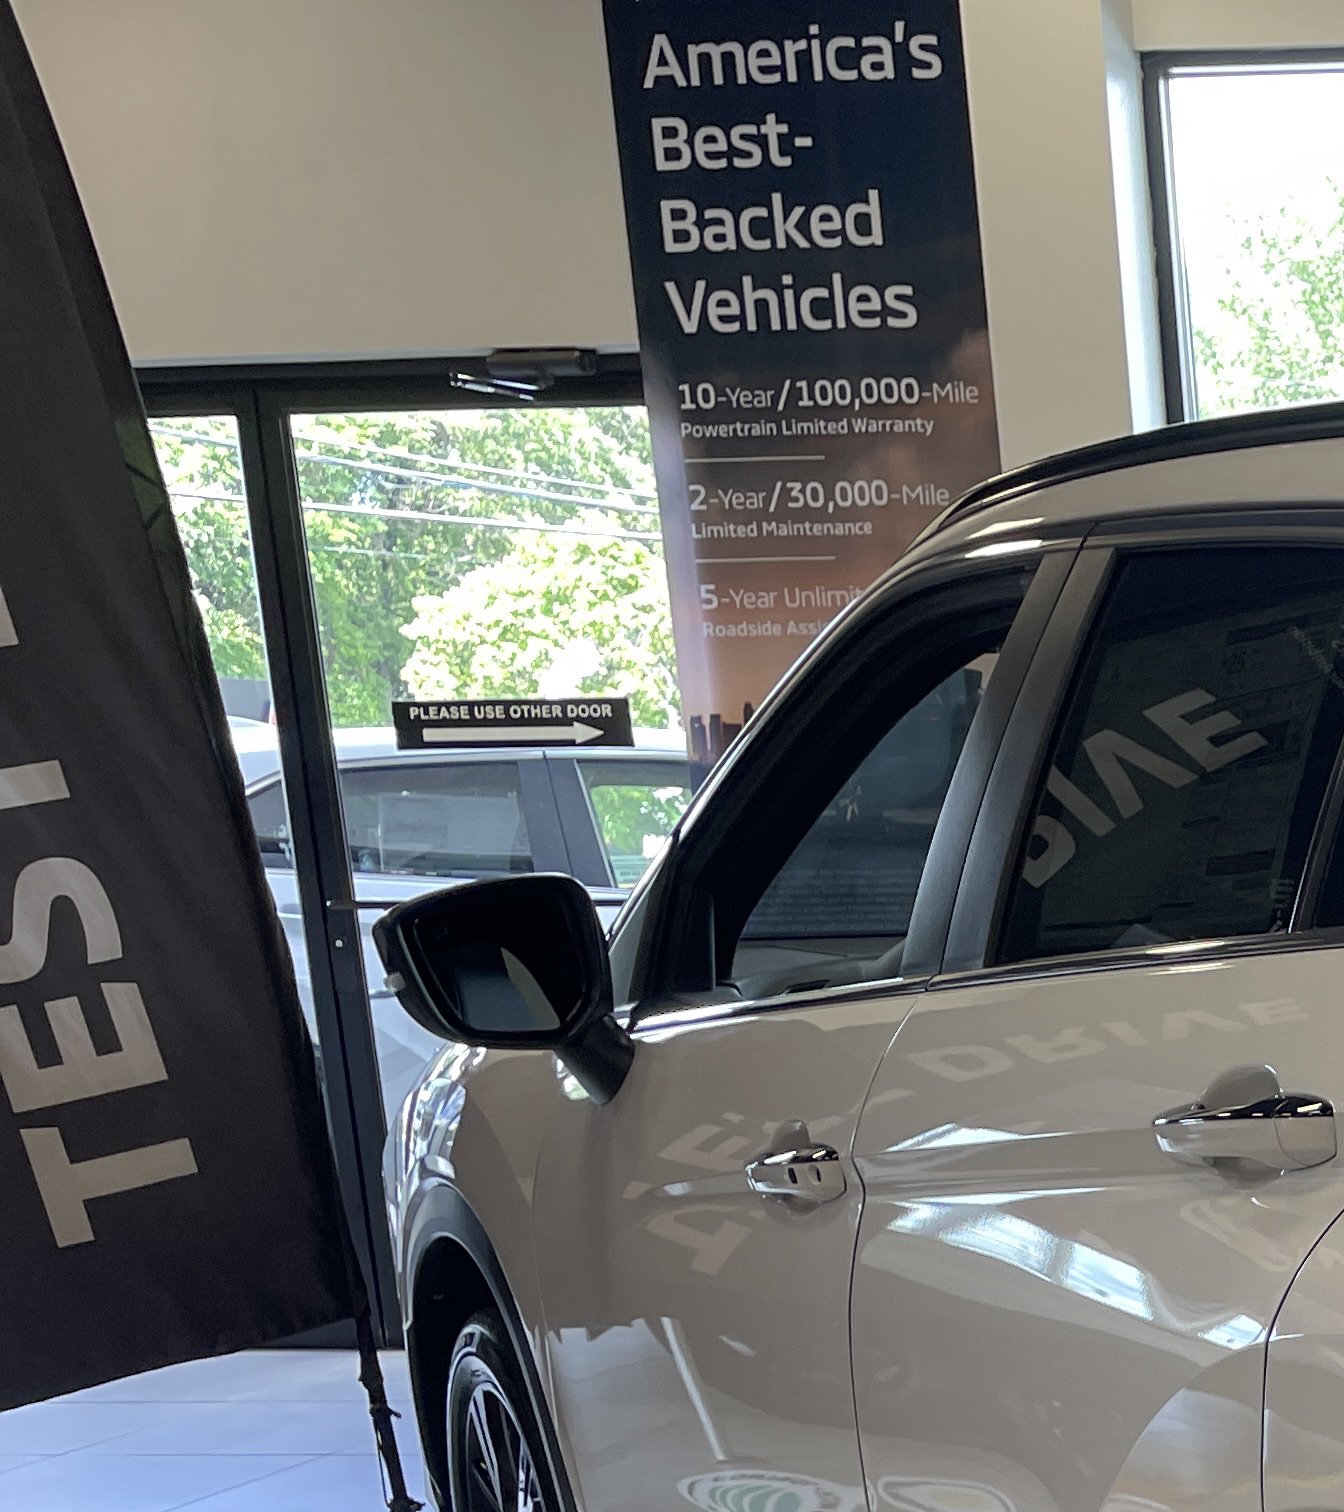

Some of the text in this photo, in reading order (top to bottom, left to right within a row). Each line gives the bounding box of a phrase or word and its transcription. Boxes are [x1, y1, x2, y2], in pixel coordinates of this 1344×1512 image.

[642, 20, 943, 89] America's
[650, 112, 814, 172] Best-
[659, 188, 885, 254] Backed
[664, 272, 918, 335] Vehicles
[680, 415, 935, 439] Powertrain Limited Warranty
[691, 518, 873, 539] Limited Maintenance
[699, 583, 779, 611] 5-Year
[702, 620, 783, 638] Roadside
[408, 703, 613, 720] PLEASE USE OTHER DOOR
